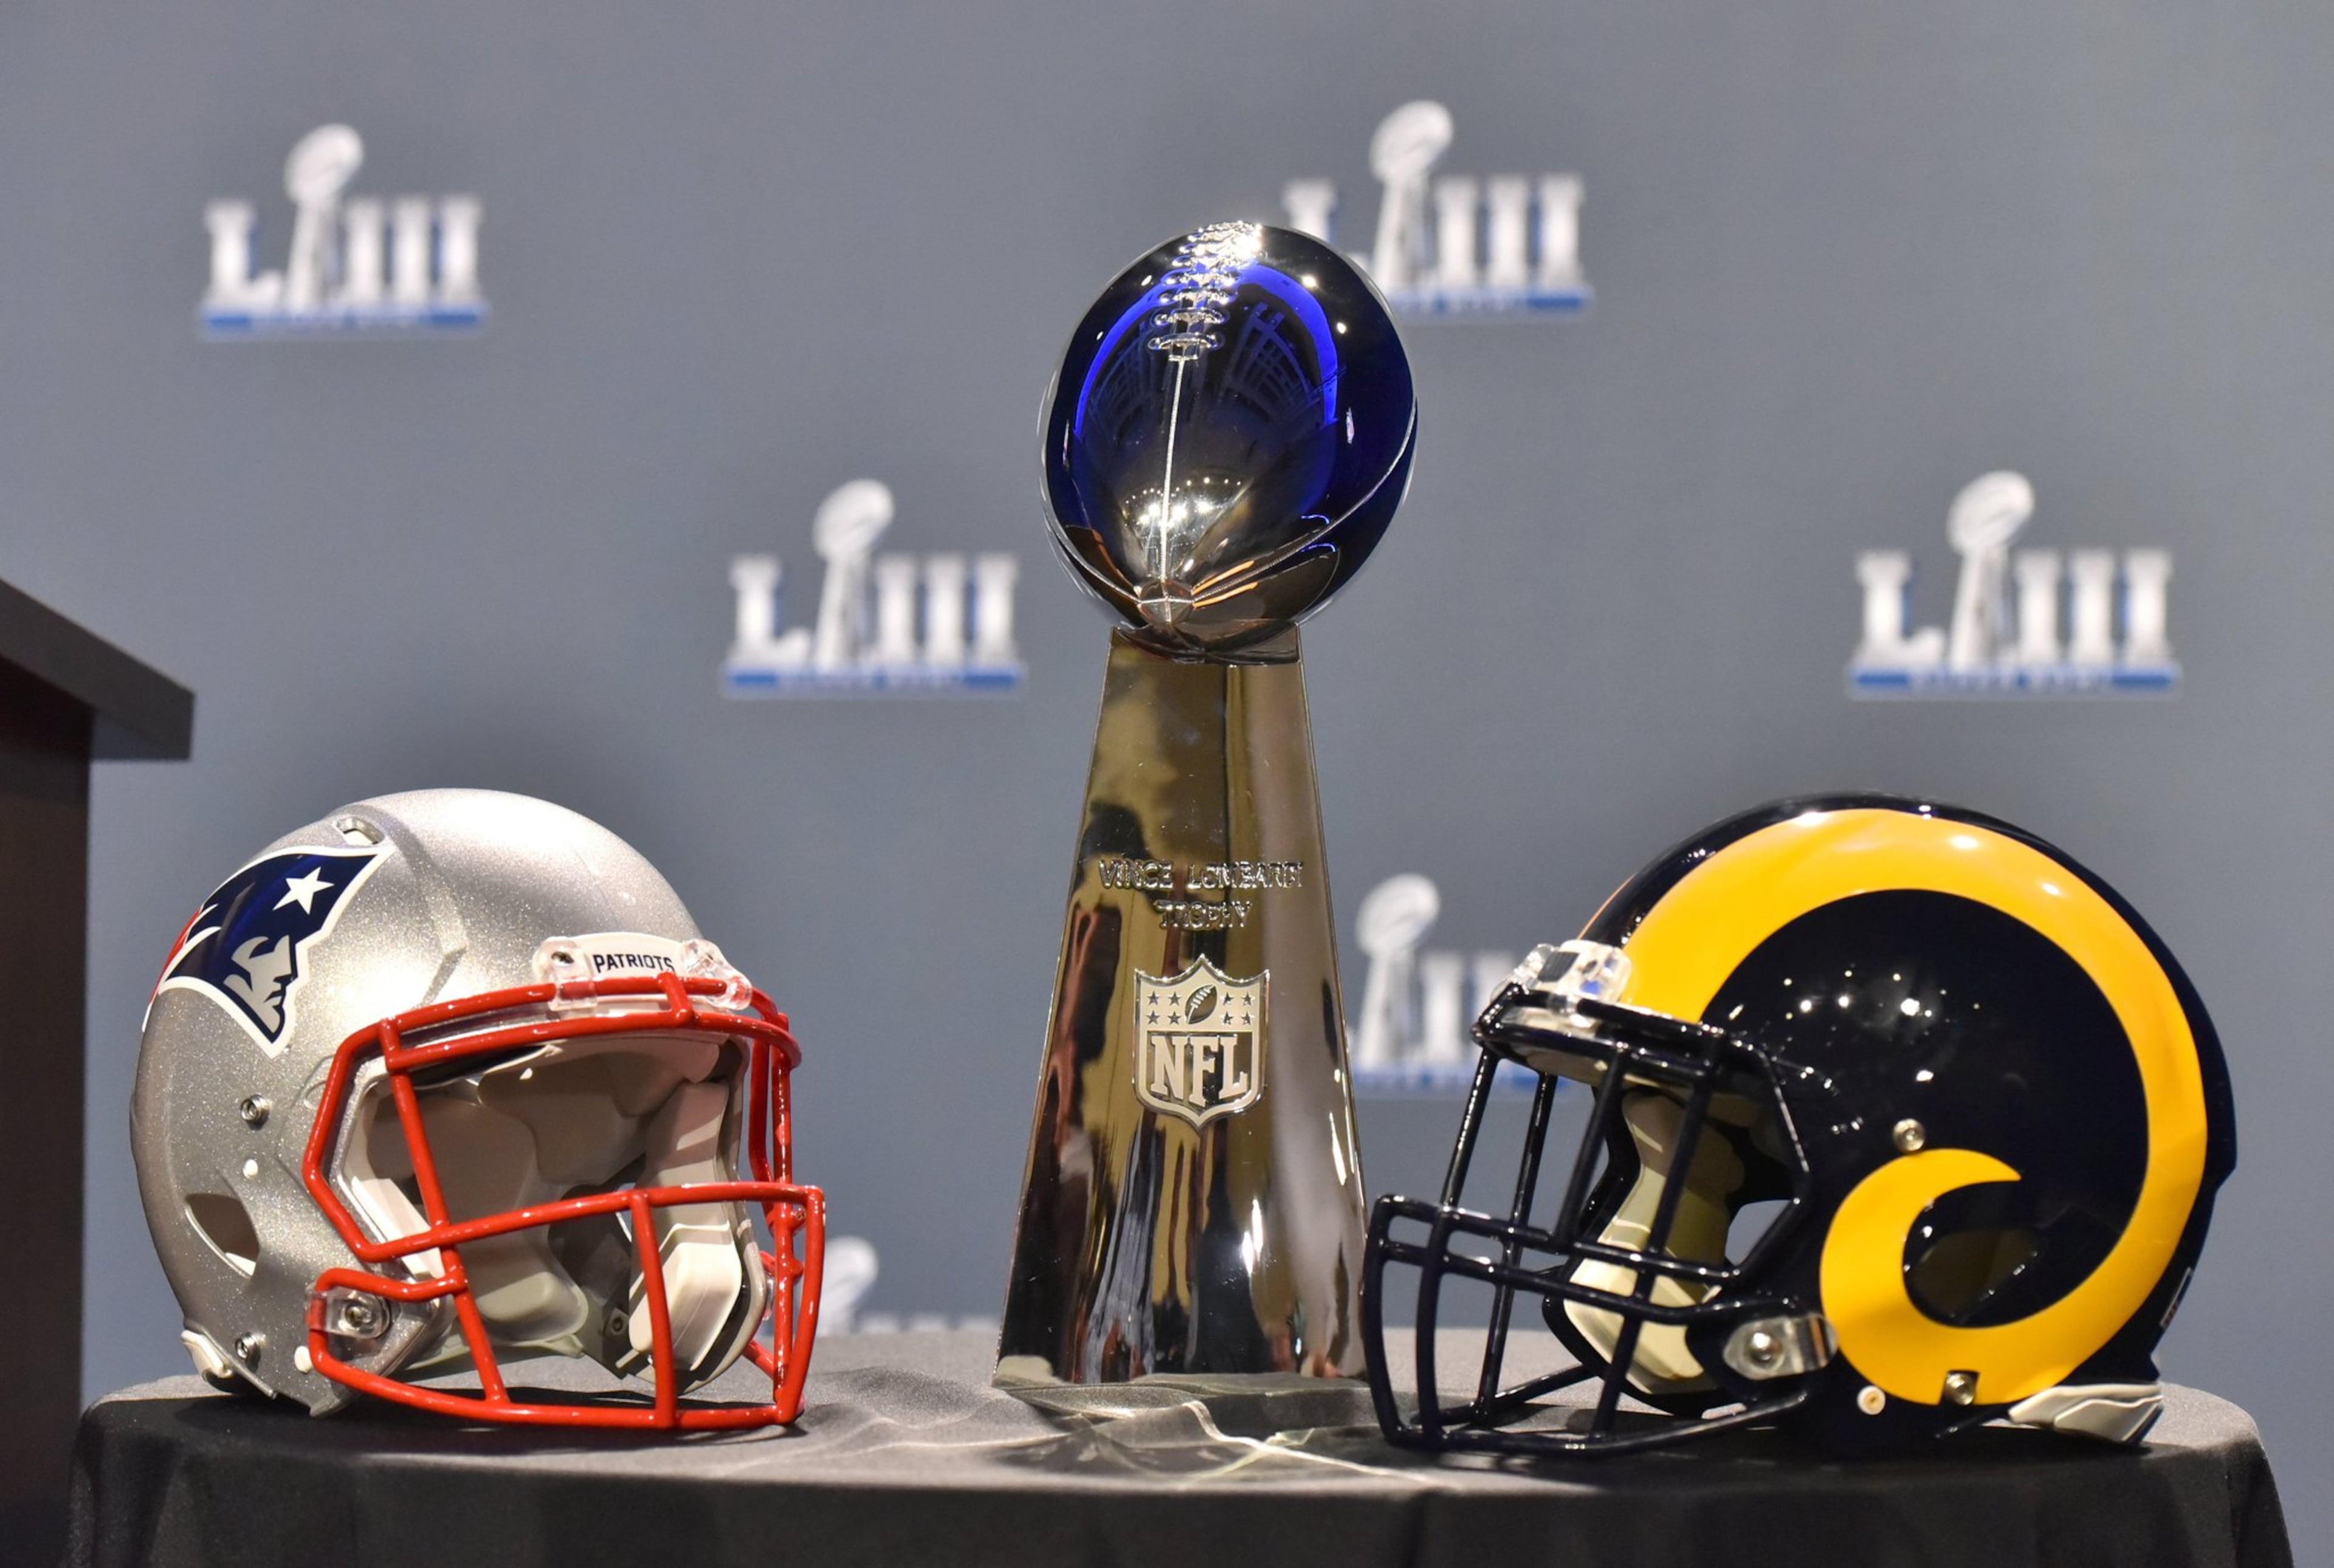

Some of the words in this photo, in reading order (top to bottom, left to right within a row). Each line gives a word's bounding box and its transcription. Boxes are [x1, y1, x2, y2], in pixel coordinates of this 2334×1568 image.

[1099, 859, 1174, 889] VINCE
[593, 954, 676, 974] PATRIOTS
[1150, 1035, 1248, 1107] NFL
